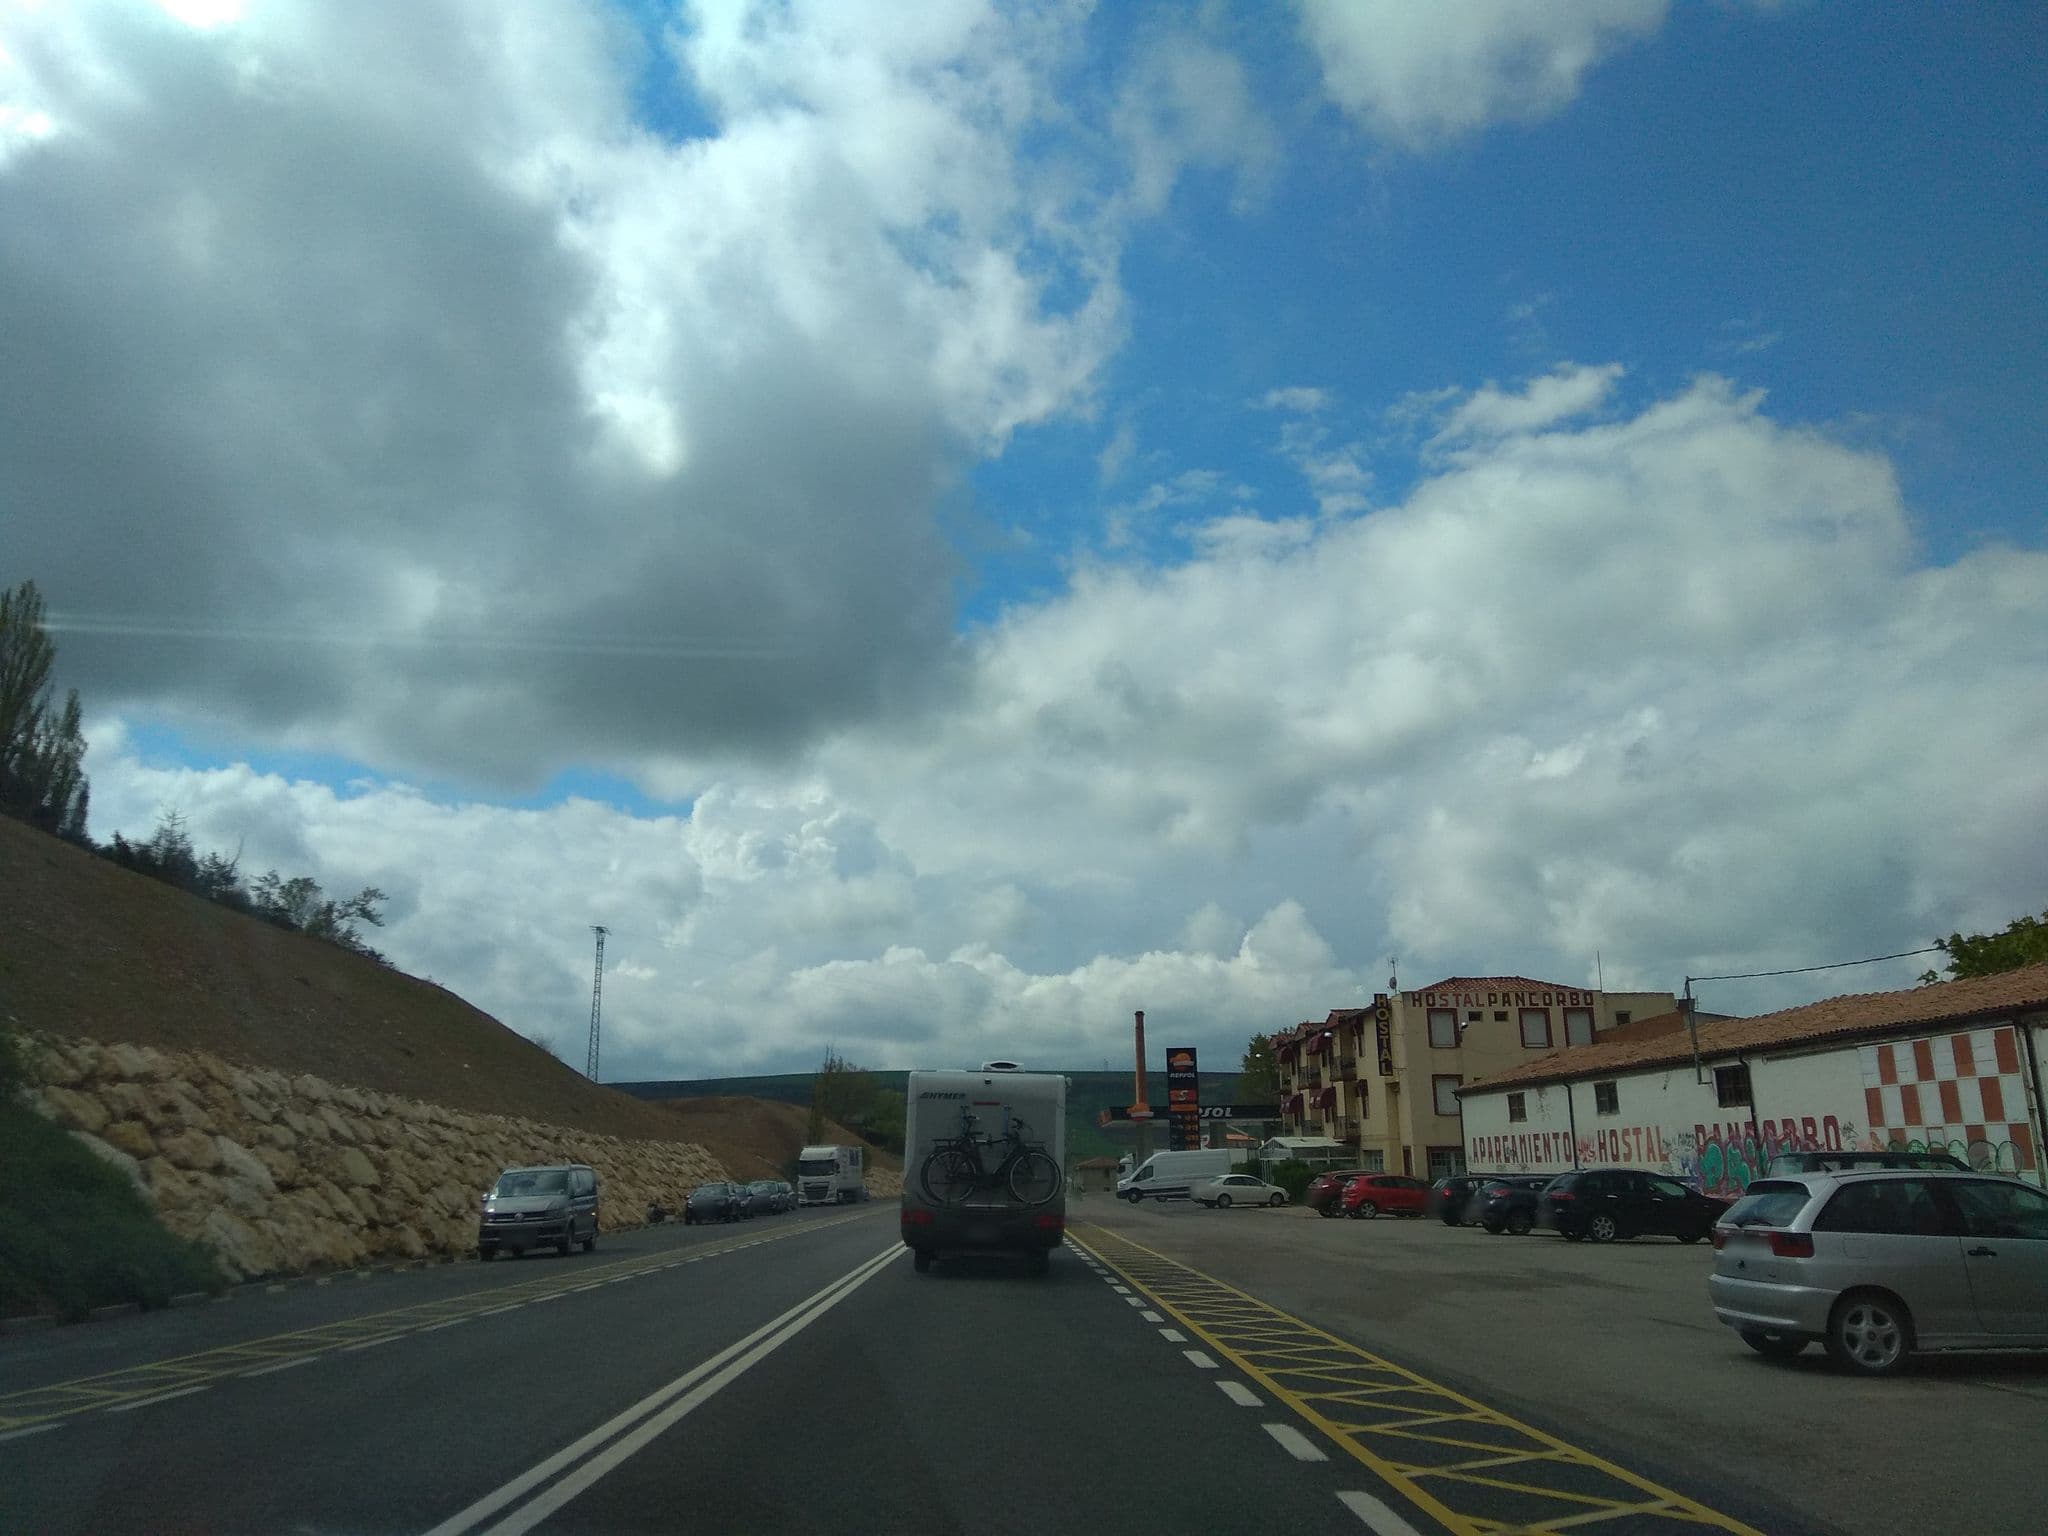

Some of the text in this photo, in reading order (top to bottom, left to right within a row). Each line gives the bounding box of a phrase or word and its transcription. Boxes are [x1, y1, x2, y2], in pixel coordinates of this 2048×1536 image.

[1412, 992, 1594, 1008] HOSTAL PANCORBO
[1375, 995, 1392, 1075] HOSTAL
[1472, 1131, 1573, 1164] APARCAMIENTO
[1597, 1125, 1670, 1163] HOSTAL
